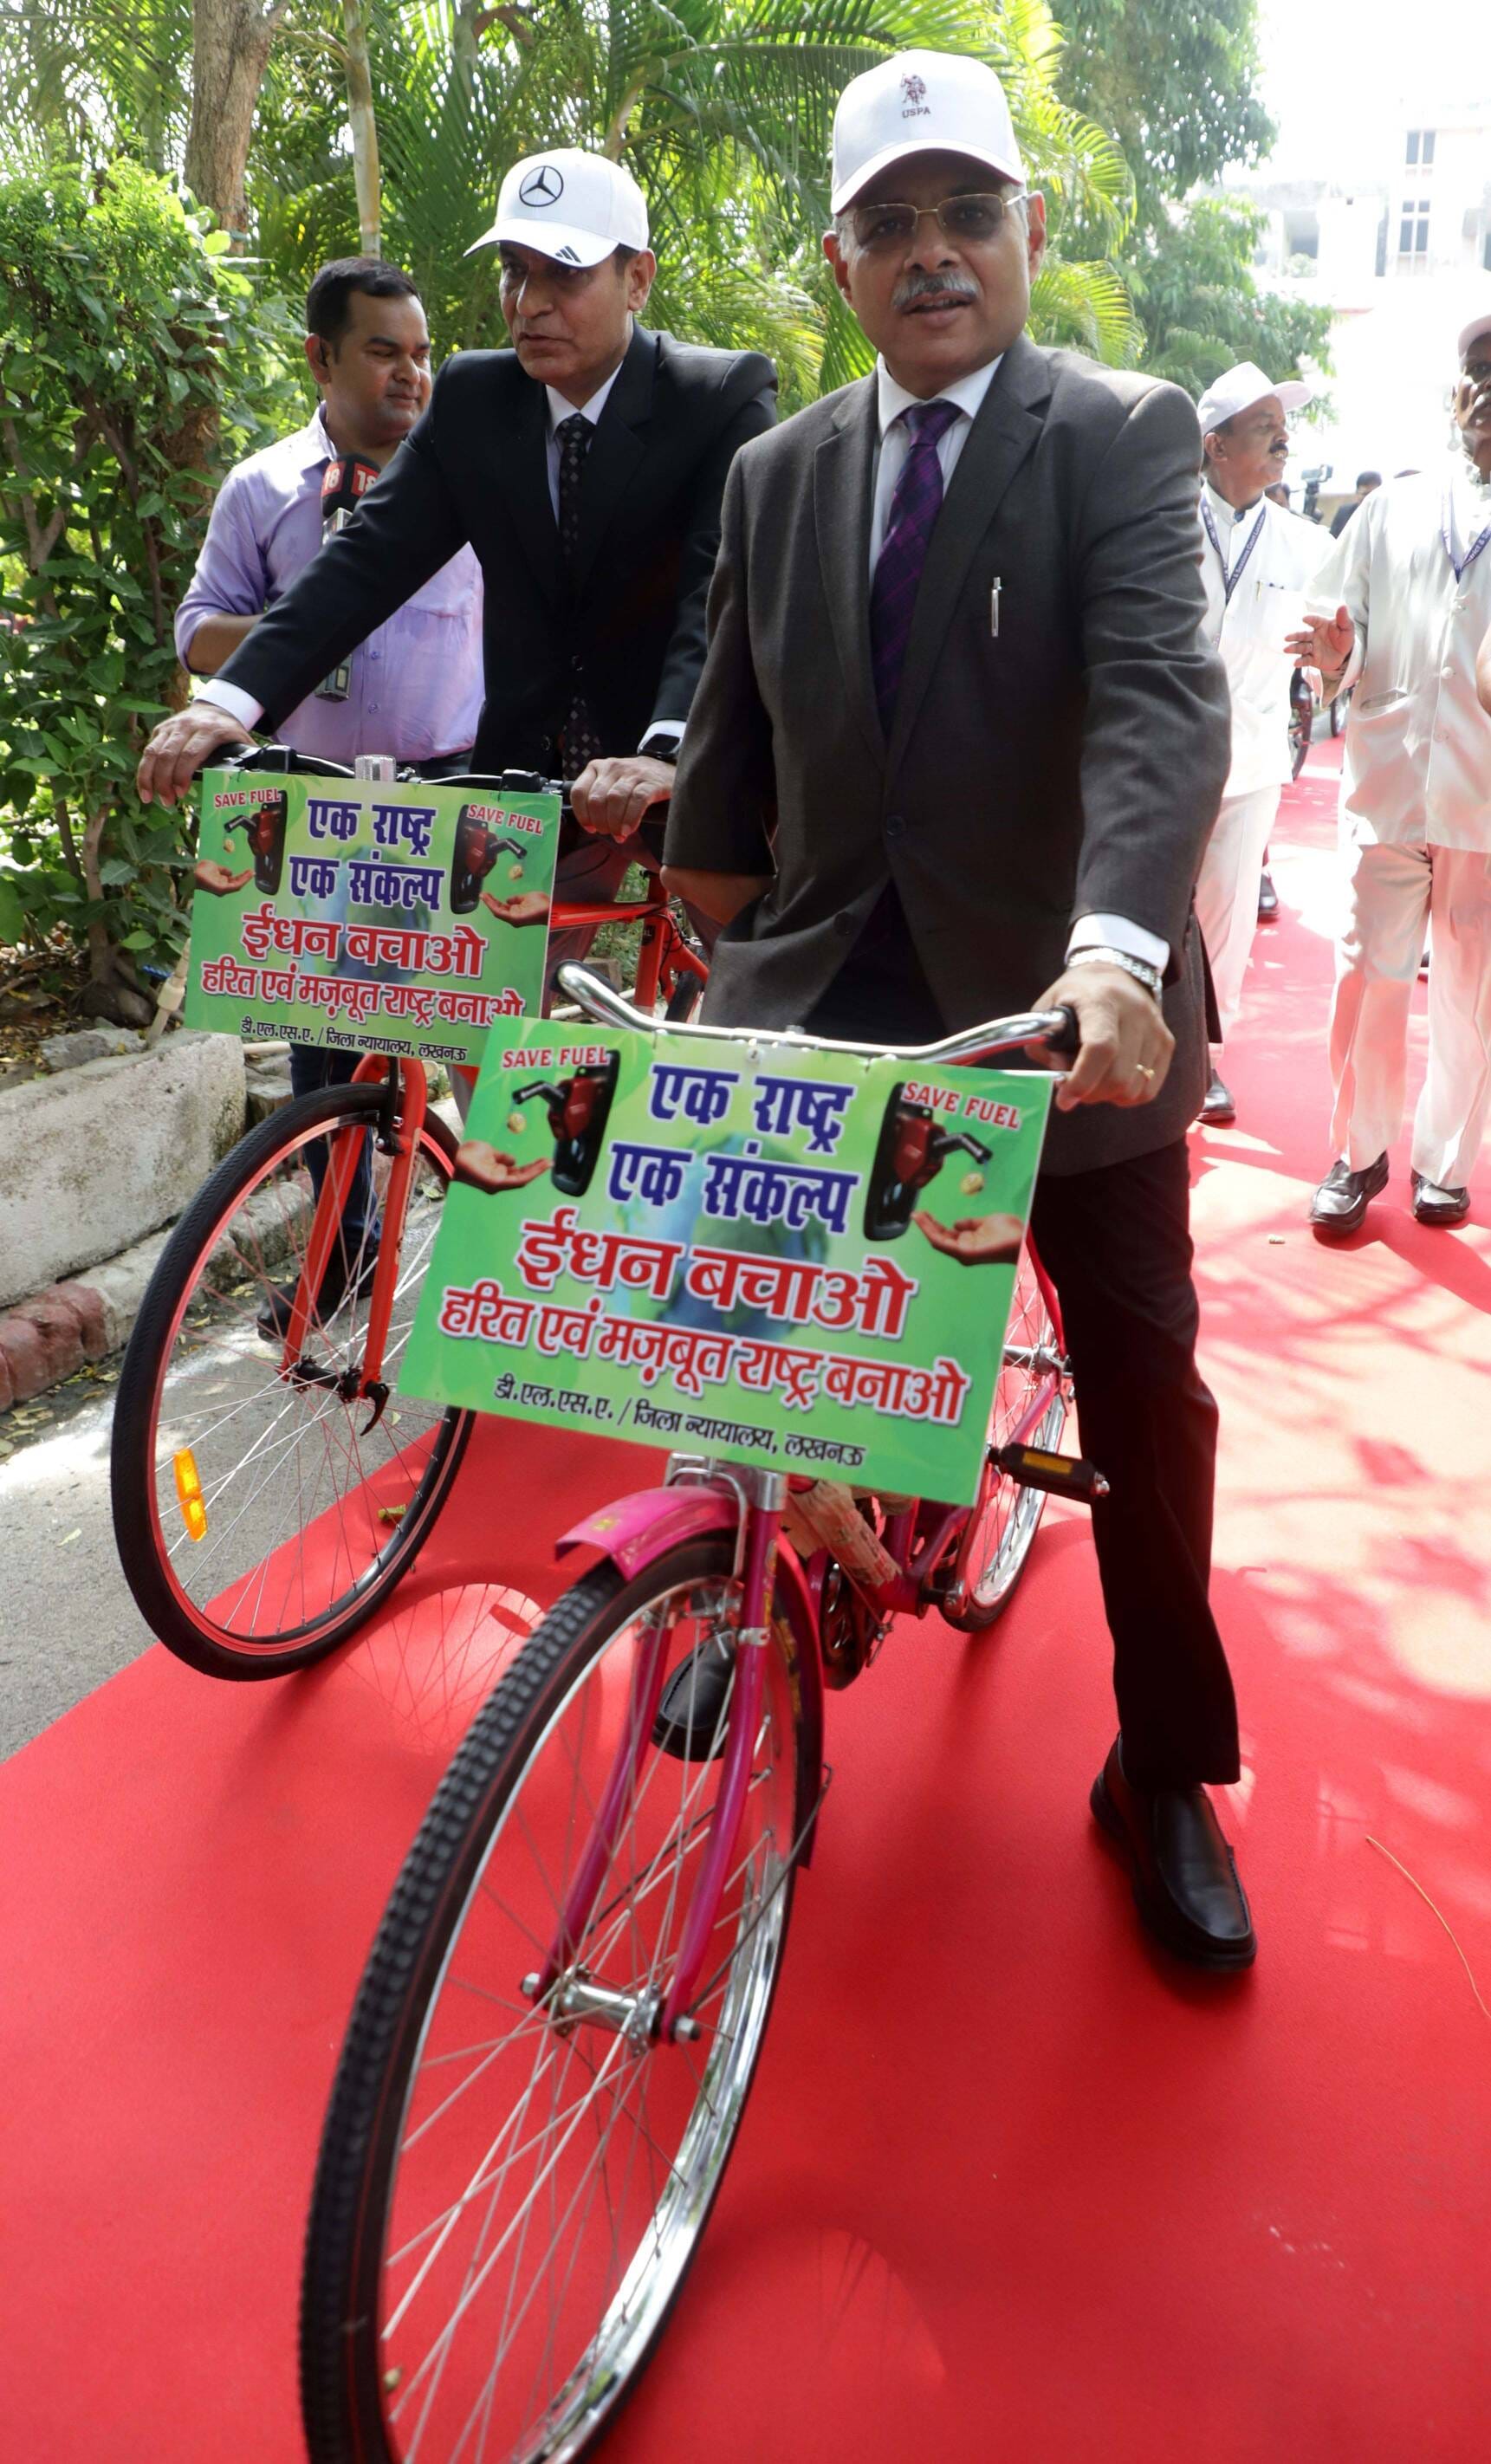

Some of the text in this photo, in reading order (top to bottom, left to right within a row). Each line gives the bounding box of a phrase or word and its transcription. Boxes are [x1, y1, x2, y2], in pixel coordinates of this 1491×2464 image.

[902, 107, 930, 119] USPA
[215, 788, 281, 807] SAVE FUEL
[469, 804, 542, 834] SAVE FUEL
[308, 800, 435, 856] एक राष्ट्र
[290, 852, 444, 911] एक संकल्प
[348, 924, 486, 976] बचाओ
[202, 956, 523, 1024] हरित एवं मज़बूत राष्ट्र बनाओ
[242, 1016, 467, 1061] डी.एल.एस.ए. / जिला न्यायालय, लखनऊ
[502, 1046, 609, 1068] SAVE FUEL
[651, 1065, 854, 1153] एक राष्ट्र
[904, 1082, 1020, 1129] SAVE FUEL
[608, 1141, 859, 1233] एक संकल्प
[689, 1248, 914, 1335] बचाओ
[441, 1281, 967, 1421] हरित एवं मज़बूत राष्ट्र बनाओ
[494, 1372, 866, 1467] डी.एल.एस.ए. / जिला न्यायालय, लखनऊ
